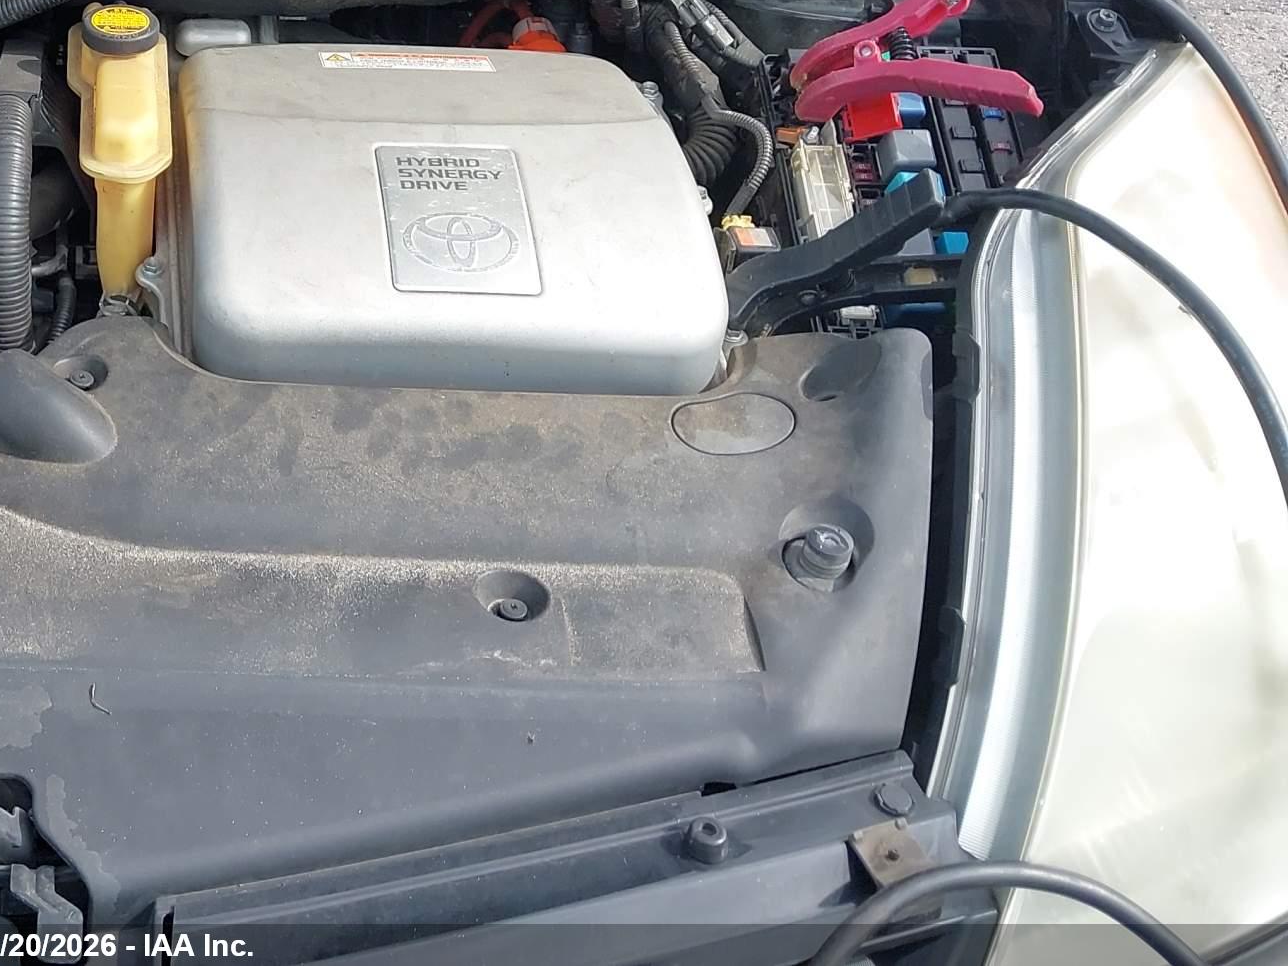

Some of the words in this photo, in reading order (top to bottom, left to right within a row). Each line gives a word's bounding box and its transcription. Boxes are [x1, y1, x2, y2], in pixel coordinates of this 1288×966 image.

[396, 157, 480, 167] HYBRID
[398, 168, 503, 180] SYNERGY
[400, 180, 468, 191] DRIVE
